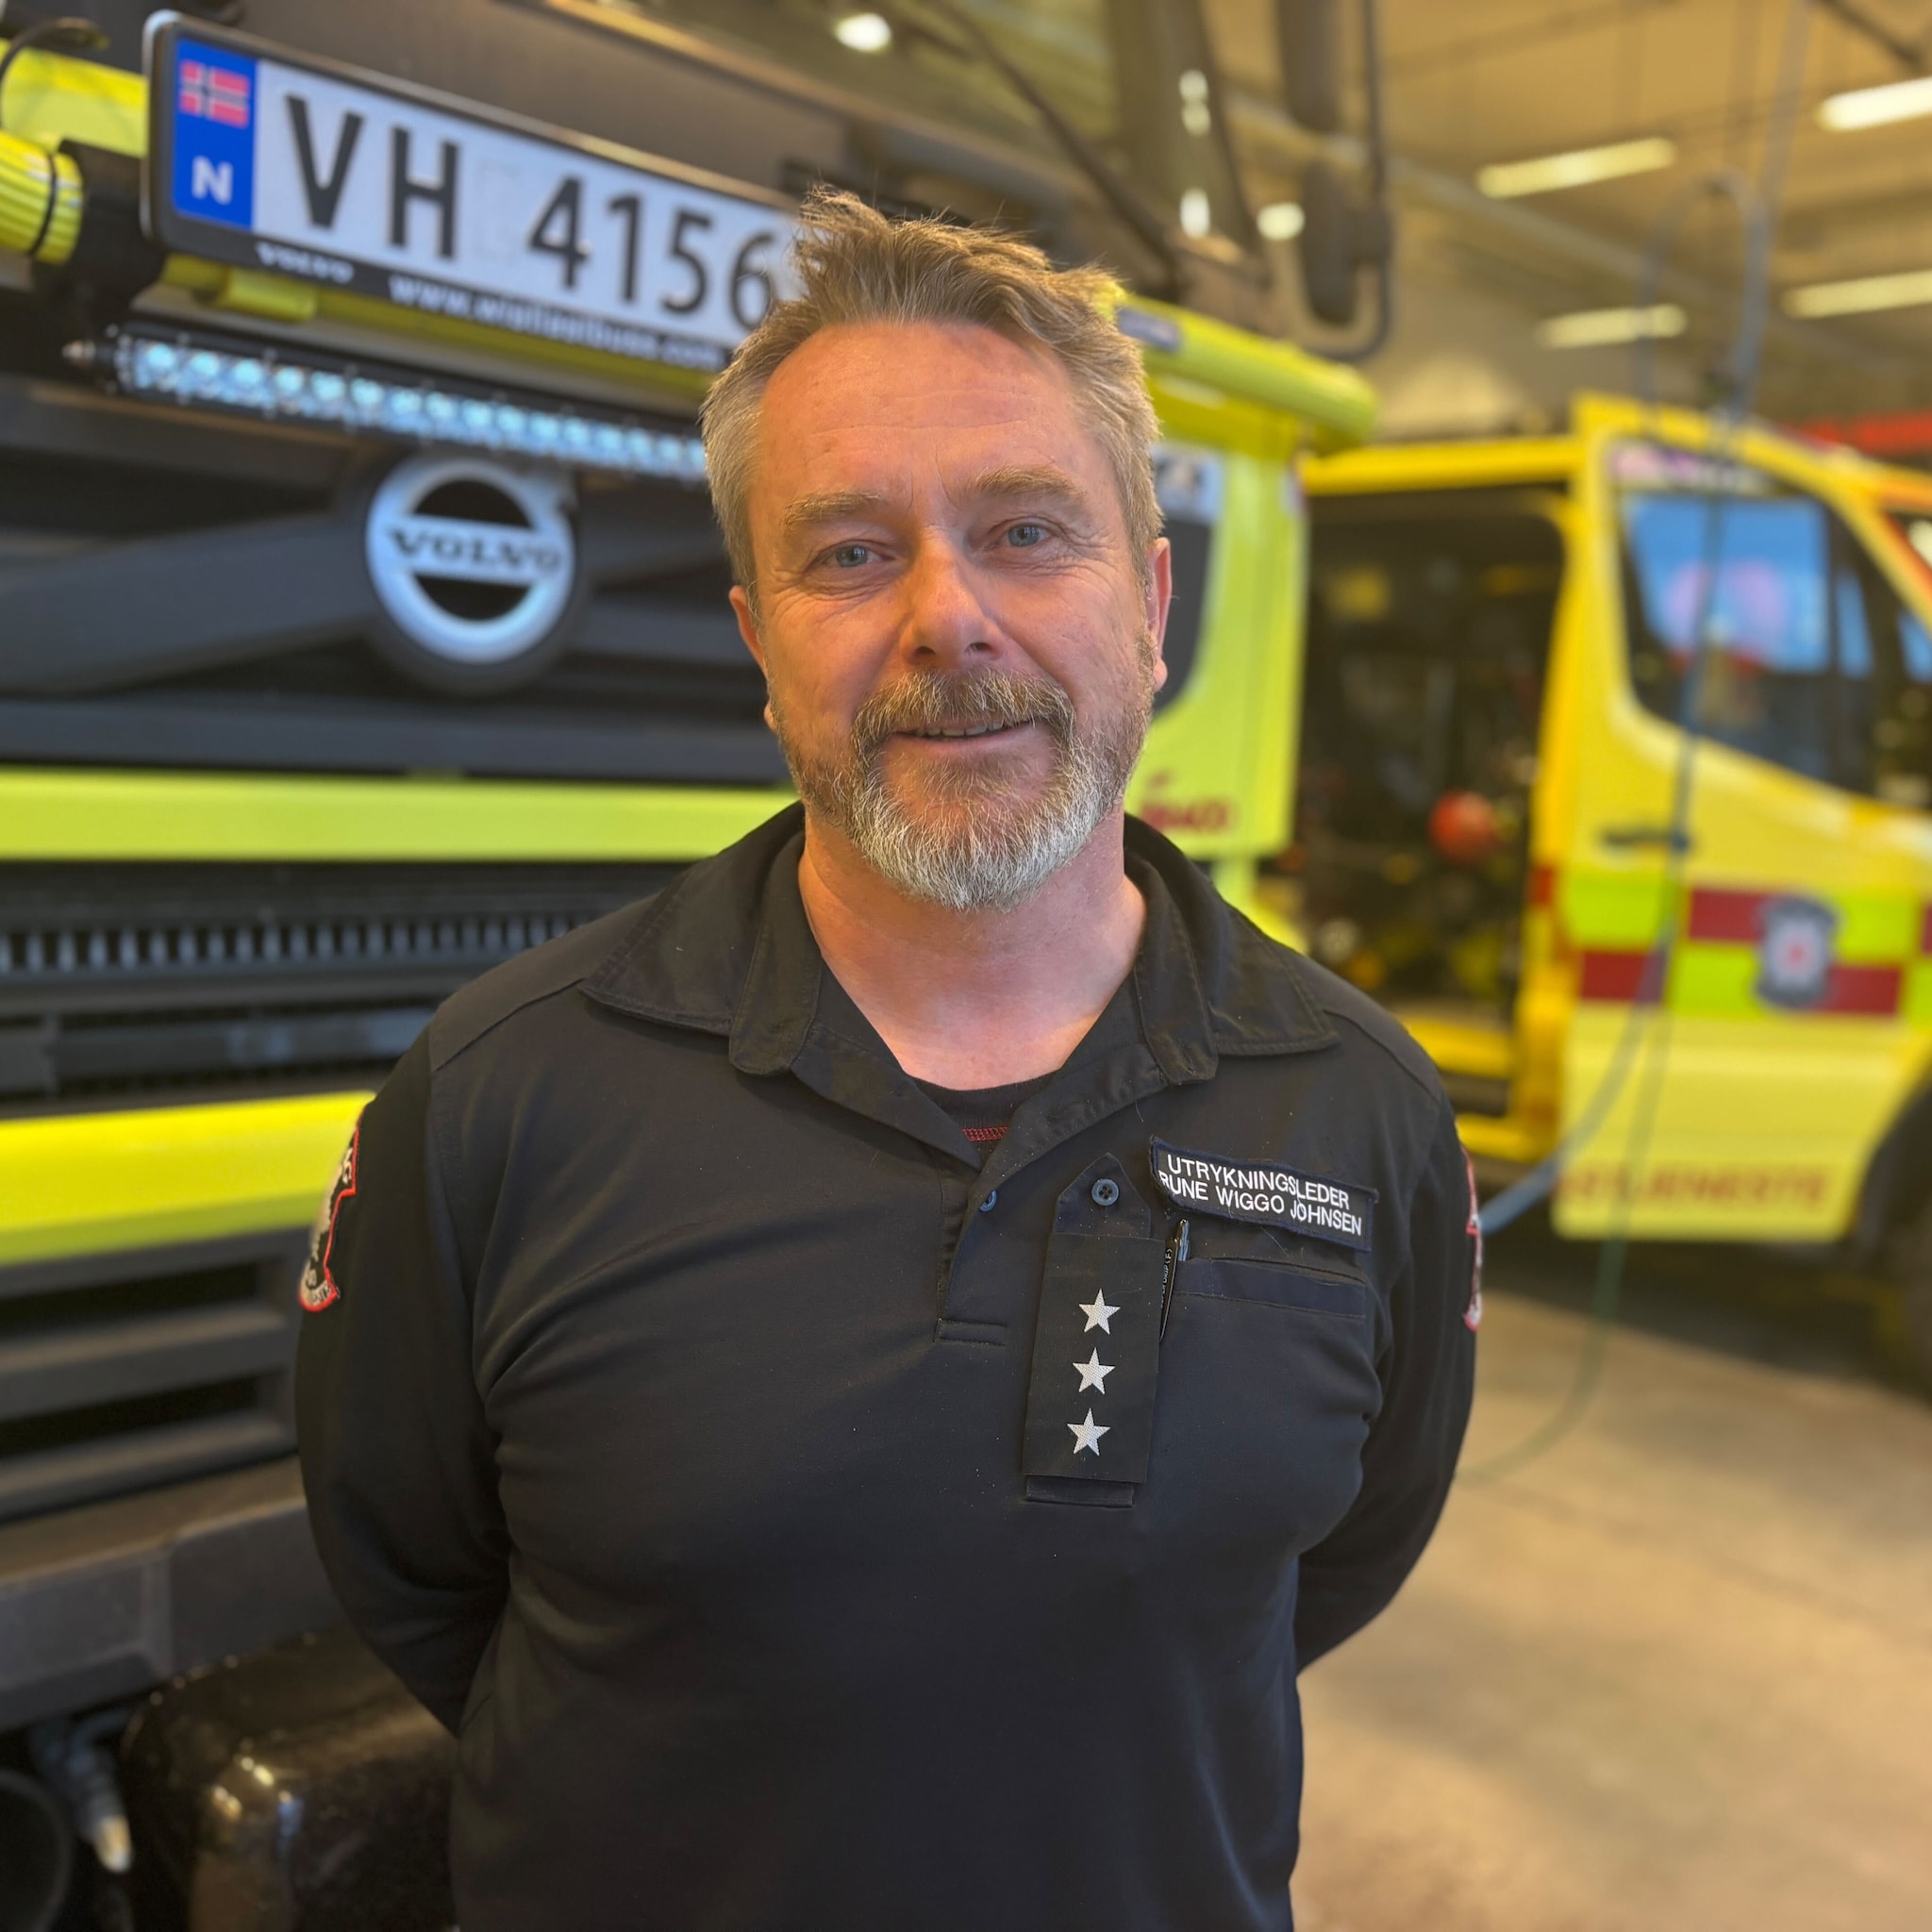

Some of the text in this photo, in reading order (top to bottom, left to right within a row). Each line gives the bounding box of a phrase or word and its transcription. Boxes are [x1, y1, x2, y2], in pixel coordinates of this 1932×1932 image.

[192, 156, 233, 205] N
[287, 92, 460, 259] VH
[255, 241, 355, 284] VOLVO
[389, 528, 561, 572] VOLVO
[1158, 1170, 1361, 1236] RUNE WIGGO JOHNSEN
[1167, 1154, 1350, 1210] UTRYKNINGSLEDER
